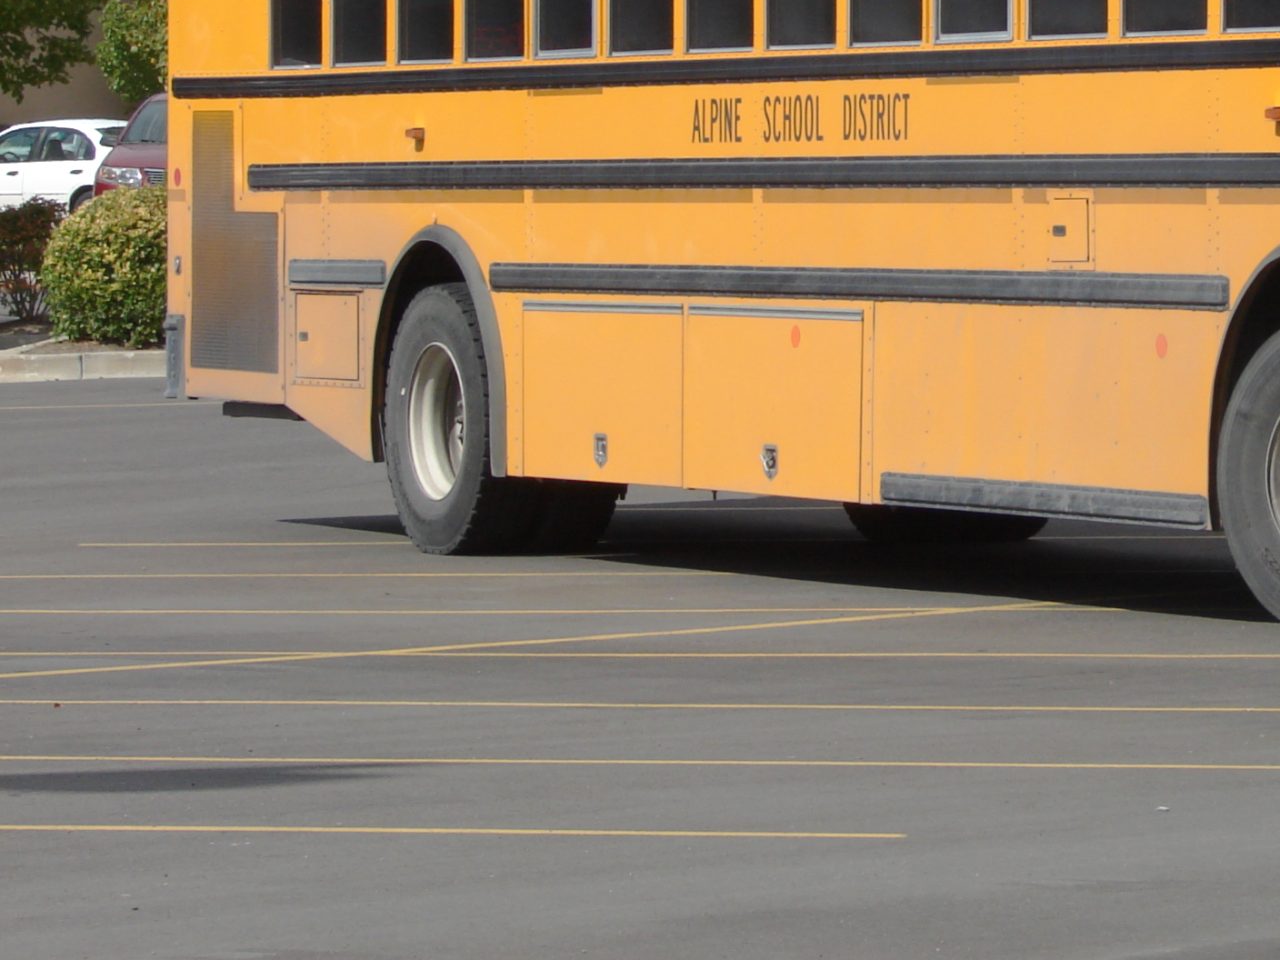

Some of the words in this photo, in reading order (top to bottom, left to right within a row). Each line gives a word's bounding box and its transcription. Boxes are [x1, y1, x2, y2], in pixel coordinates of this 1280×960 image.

[692, 97, 742, 144] ALPINE
[763, 94, 824, 143] SCHOOL
[843, 93, 911, 141] DISTRICT
